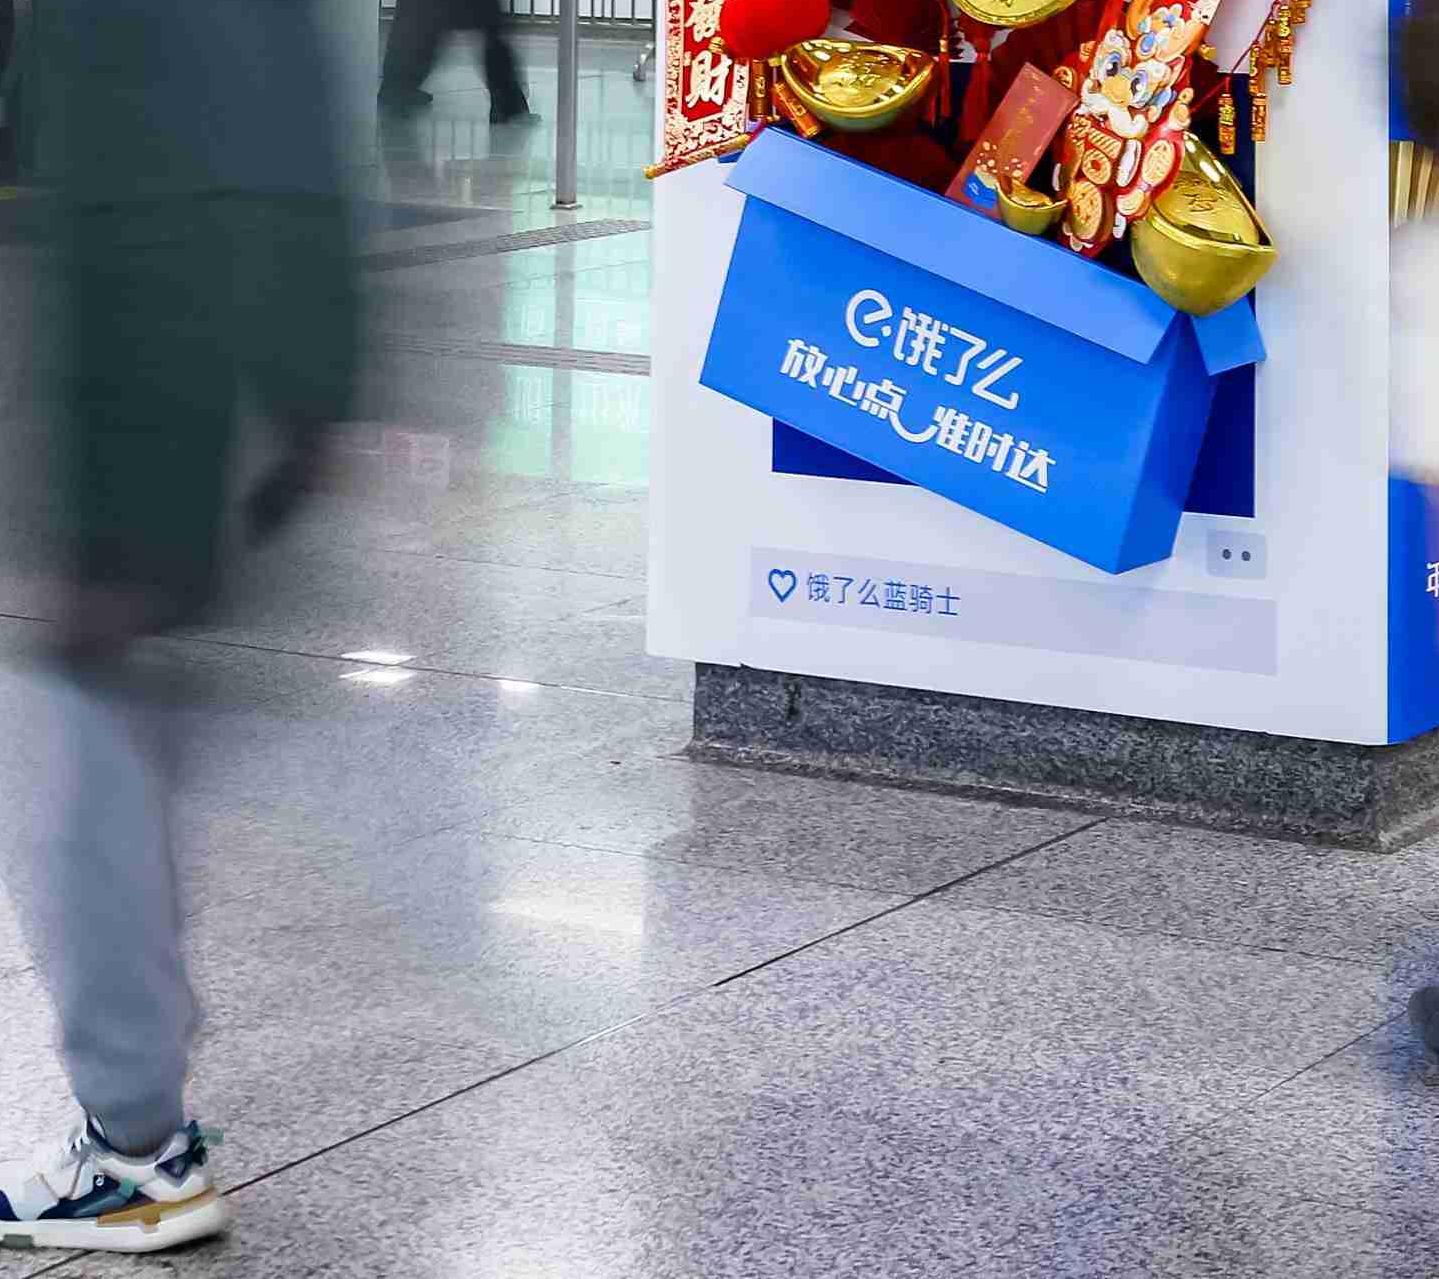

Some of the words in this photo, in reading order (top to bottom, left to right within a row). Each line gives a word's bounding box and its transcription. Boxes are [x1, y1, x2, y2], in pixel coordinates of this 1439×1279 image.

[807, 568, 963, 619] 饿了么蓝骑士
